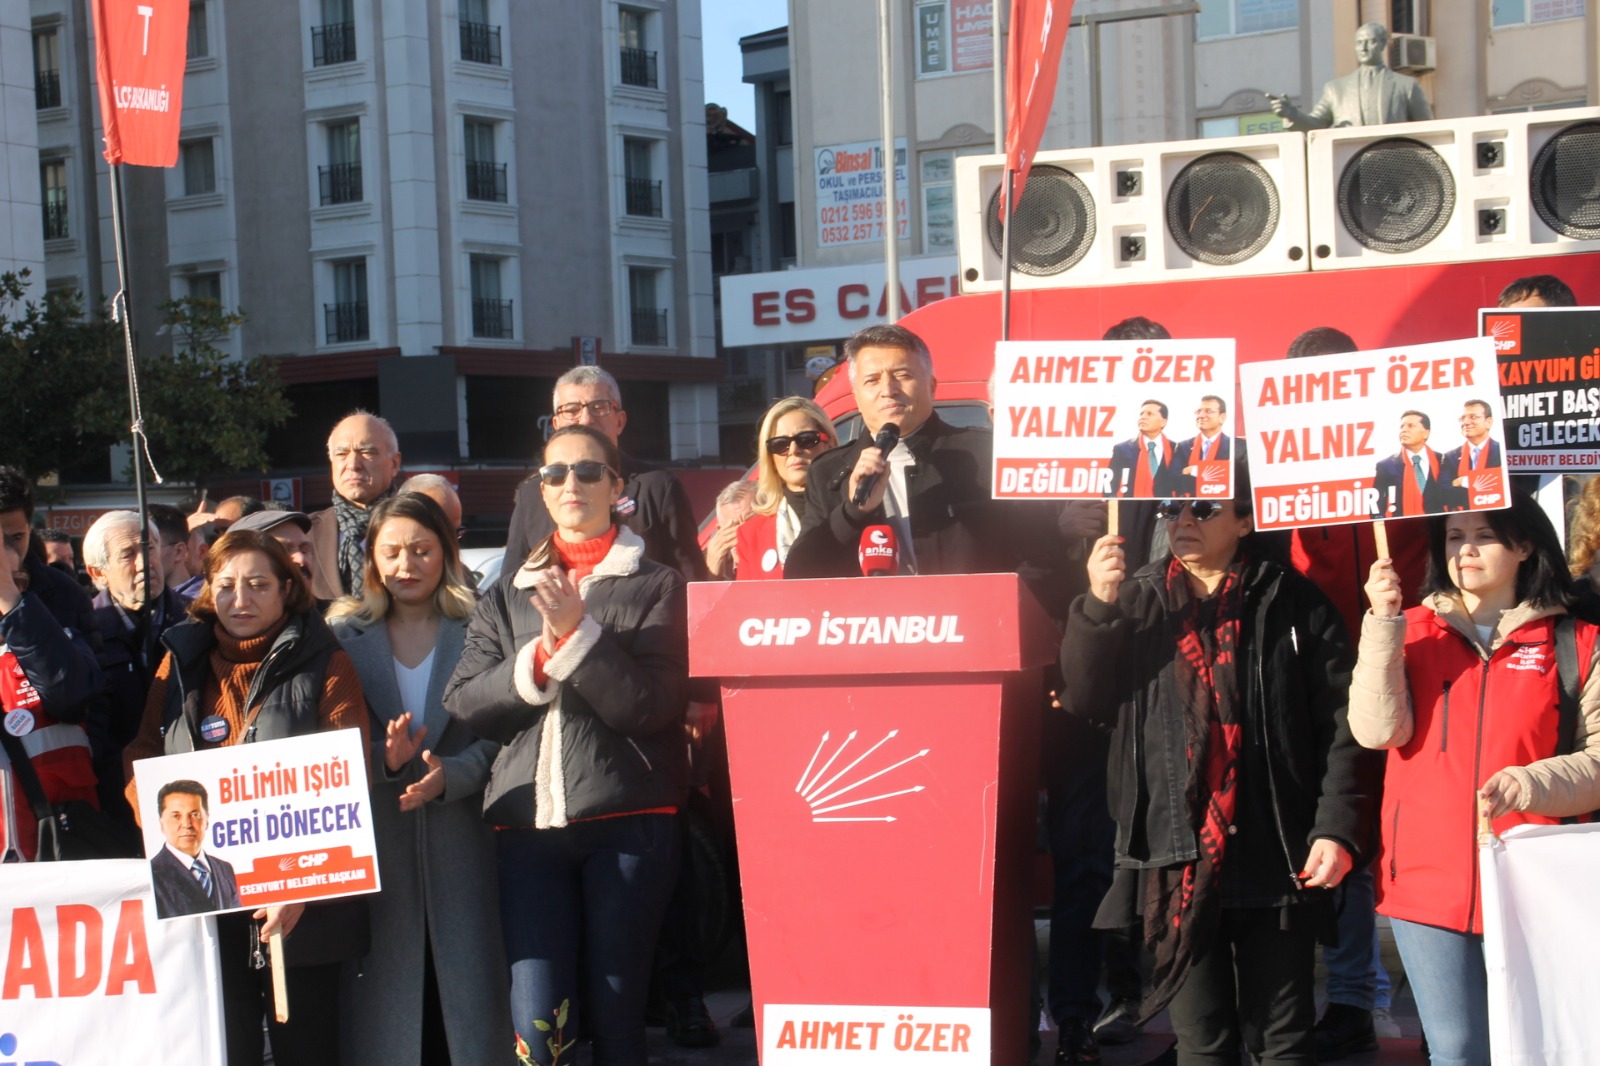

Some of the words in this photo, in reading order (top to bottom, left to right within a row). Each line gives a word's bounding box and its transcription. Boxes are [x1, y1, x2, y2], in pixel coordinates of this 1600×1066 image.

[956, 20, 993, 33] UMR
[835, 148, 873, 173] Binsal
[820, 176, 844, 190] OKUL
[847, 177, 857, 187] ve
[858, 169, 906, 186] PERSEL
[821, 205, 848, 224] 0212
[852, 202, 873, 221] 596
[822, 225, 849, 243] 0532
[853, 222, 873, 240] 257
[752, 288, 816, 326] ES
[837, 276, 958, 320] CAF
[1009, 356, 1123, 384] AHMET
[1132, 347, 1215, 383] ÖZER
[1257, 367, 1376, 407] AHMET
[1387, 354, 1475, 394] ÖZER
[1563, 387, 1600, 417] BAŞ
[1008, 406, 1117, 438] YALNIZ
[1260, 421, 1375, 465] YALNIZ
[1507, 454, 1555, 466] SENYURT
[1559, 451, 1600, 466] BELEDİ
[1000, 460, 1115, 494] DEĞİLDİR
[1200, 484, 1227, 495] CHP
[1261, 481, 1380, 524] DEĞİLDİR
[1474, 493, 1501, 506] CHP
[865, 544, 893, 554] anka
[739, 617, 811, 646] CHP
[818, 611, 965, 645] İSTANBUL
[219, 762, 298, 804] BİLİMİN
[303, 756, 350, 797] IŞIĞI
[212, 808, 260, 849] GERİ
[266, 802, 362, 841] DÖNECEK
[298, 852, 329, 869] CHP
[240, 880, 285, 895] ESENYURT
[287, 873, 327, 889] BELEDİYE
[328, 868, 366, 884] BAŞKANI
[2, 899, 157, 1000] ADA
[776, 1020, 885, 1051] AHMET
[893, 1013, 971, 1052] ÖZER
